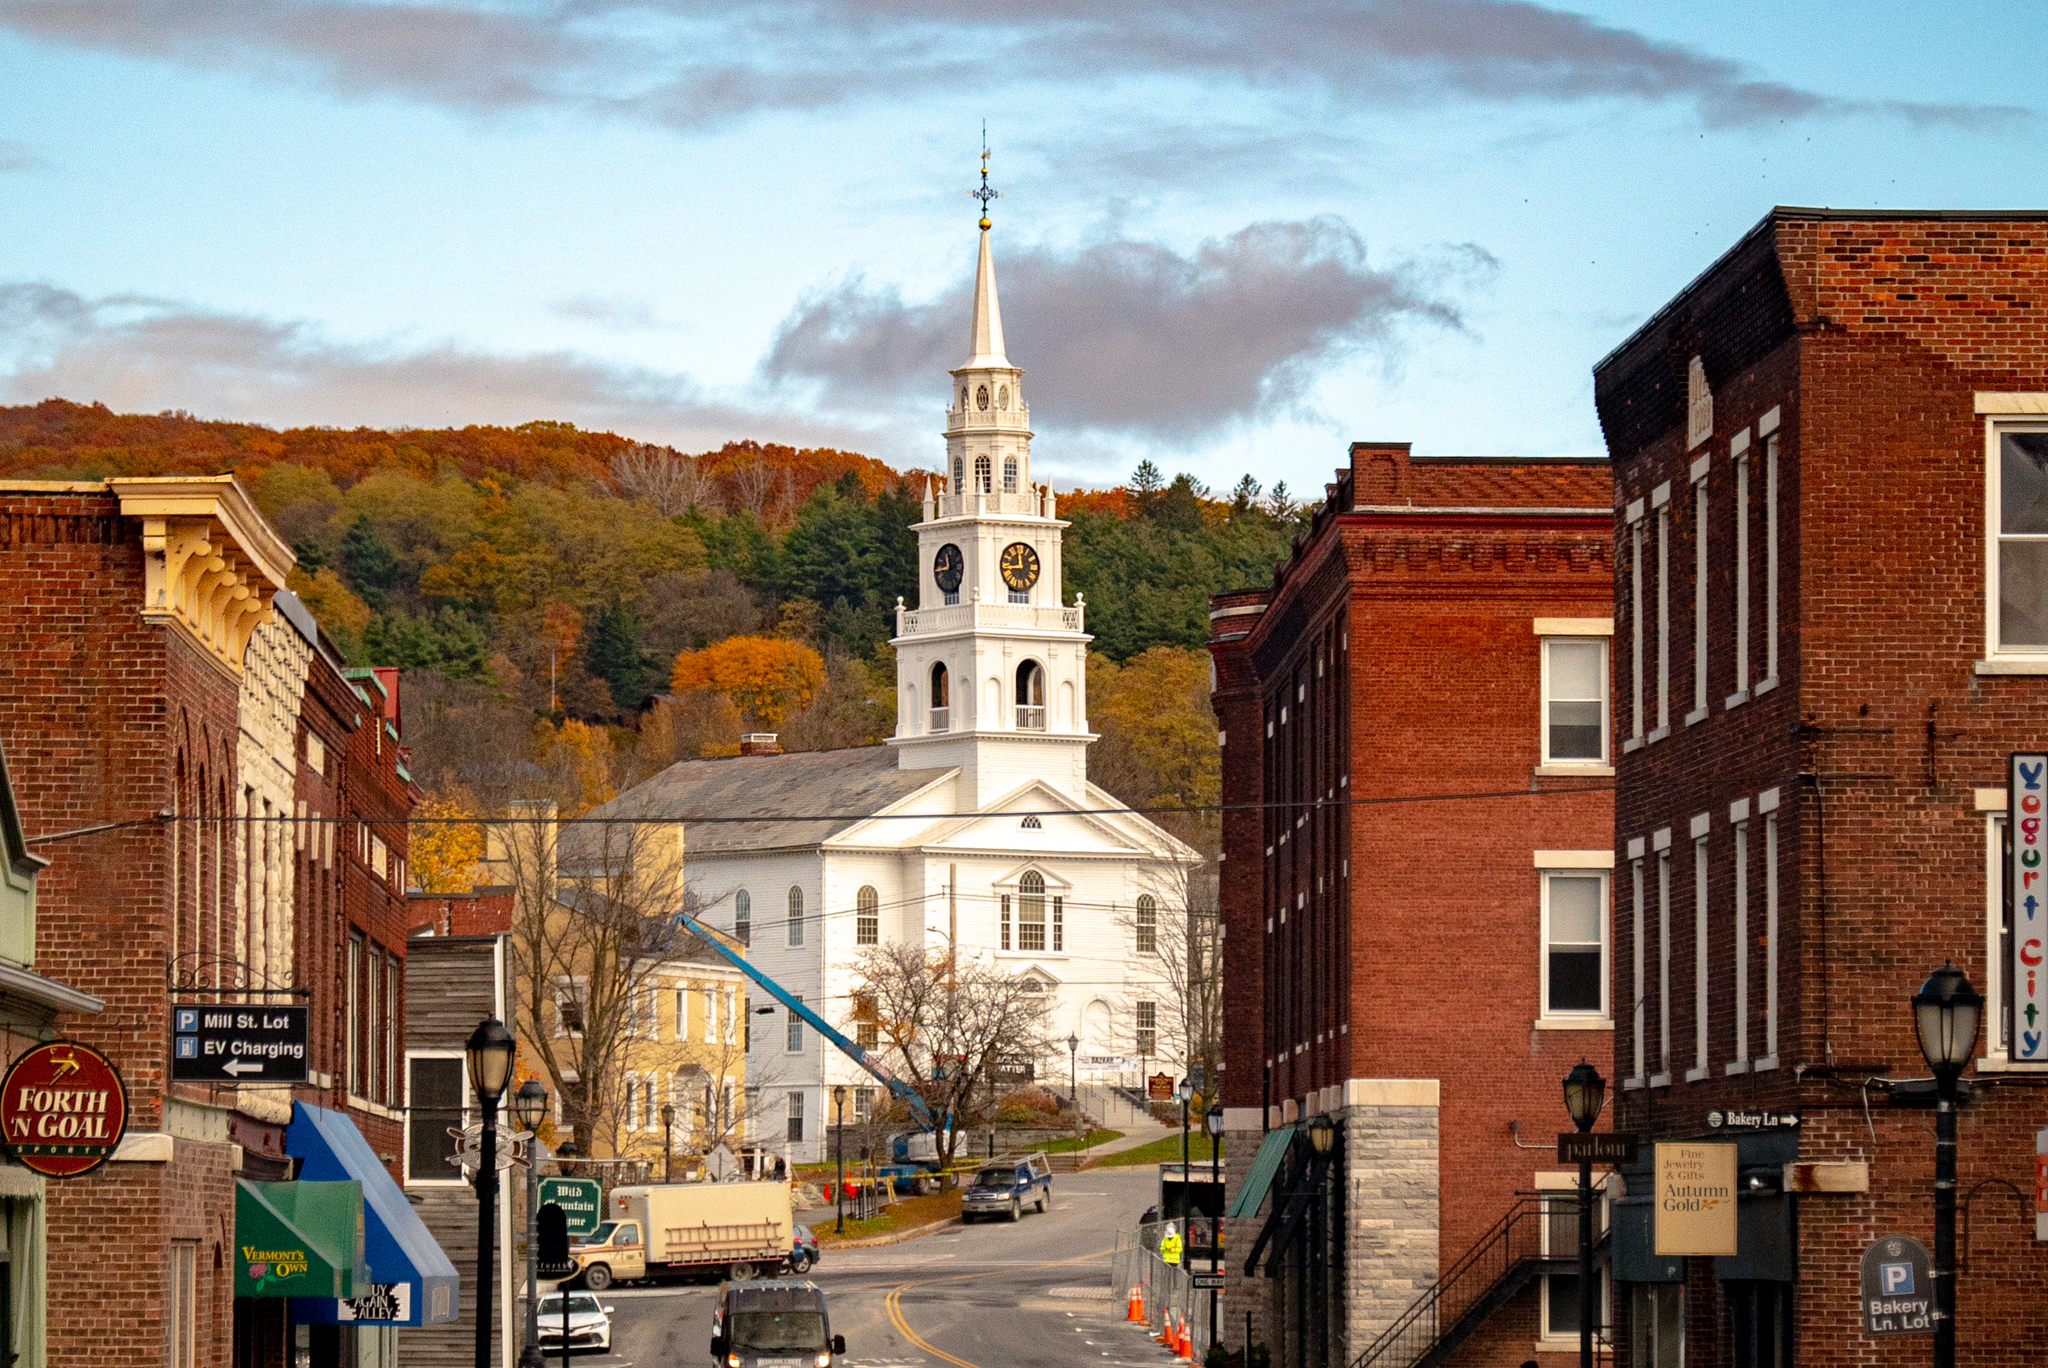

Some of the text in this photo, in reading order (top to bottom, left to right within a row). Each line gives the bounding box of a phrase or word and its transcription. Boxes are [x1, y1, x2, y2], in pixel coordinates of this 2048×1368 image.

[2018, 762, 2043, 1057] Yogurt City
[204, 1014, 232, 1029] Mill
[236, 1015, 259, 1030] St.
[263, 1014, 290, 1029] Lot
[204, 1041, 304, 1059] EV Charging
[17, 1087, 109, 1113] FORTH
[37, 1113, 110, 1139] GOAL
[1727, 1111, 1778, 1128] Bakery Ln
[17, 1146, 107, 1155] SPORTS
[1680, 1149, 1705, 1159] Fine
[1663, 1160, 1704, 1170] Jewelry
[1666, 1171, 1705, 1181] & Gifts
[557, 1186, 582, 1197] Wild
[1665, 1183, 1730, 1197] Autumn
[1664, 1198, 1700, 1212] Gold
[242, 1245, 305, 1261] VERMONT'S
[276, 1263, 308, 1277] OWN
[354, 1296, 389, 1308] AGAIN
[1870, 1300, 1929, 1316] Bakery
[358, 1307, 394, 1320] ALLEY
[1872, 1315, 1931, 1331] Ln. Lot
